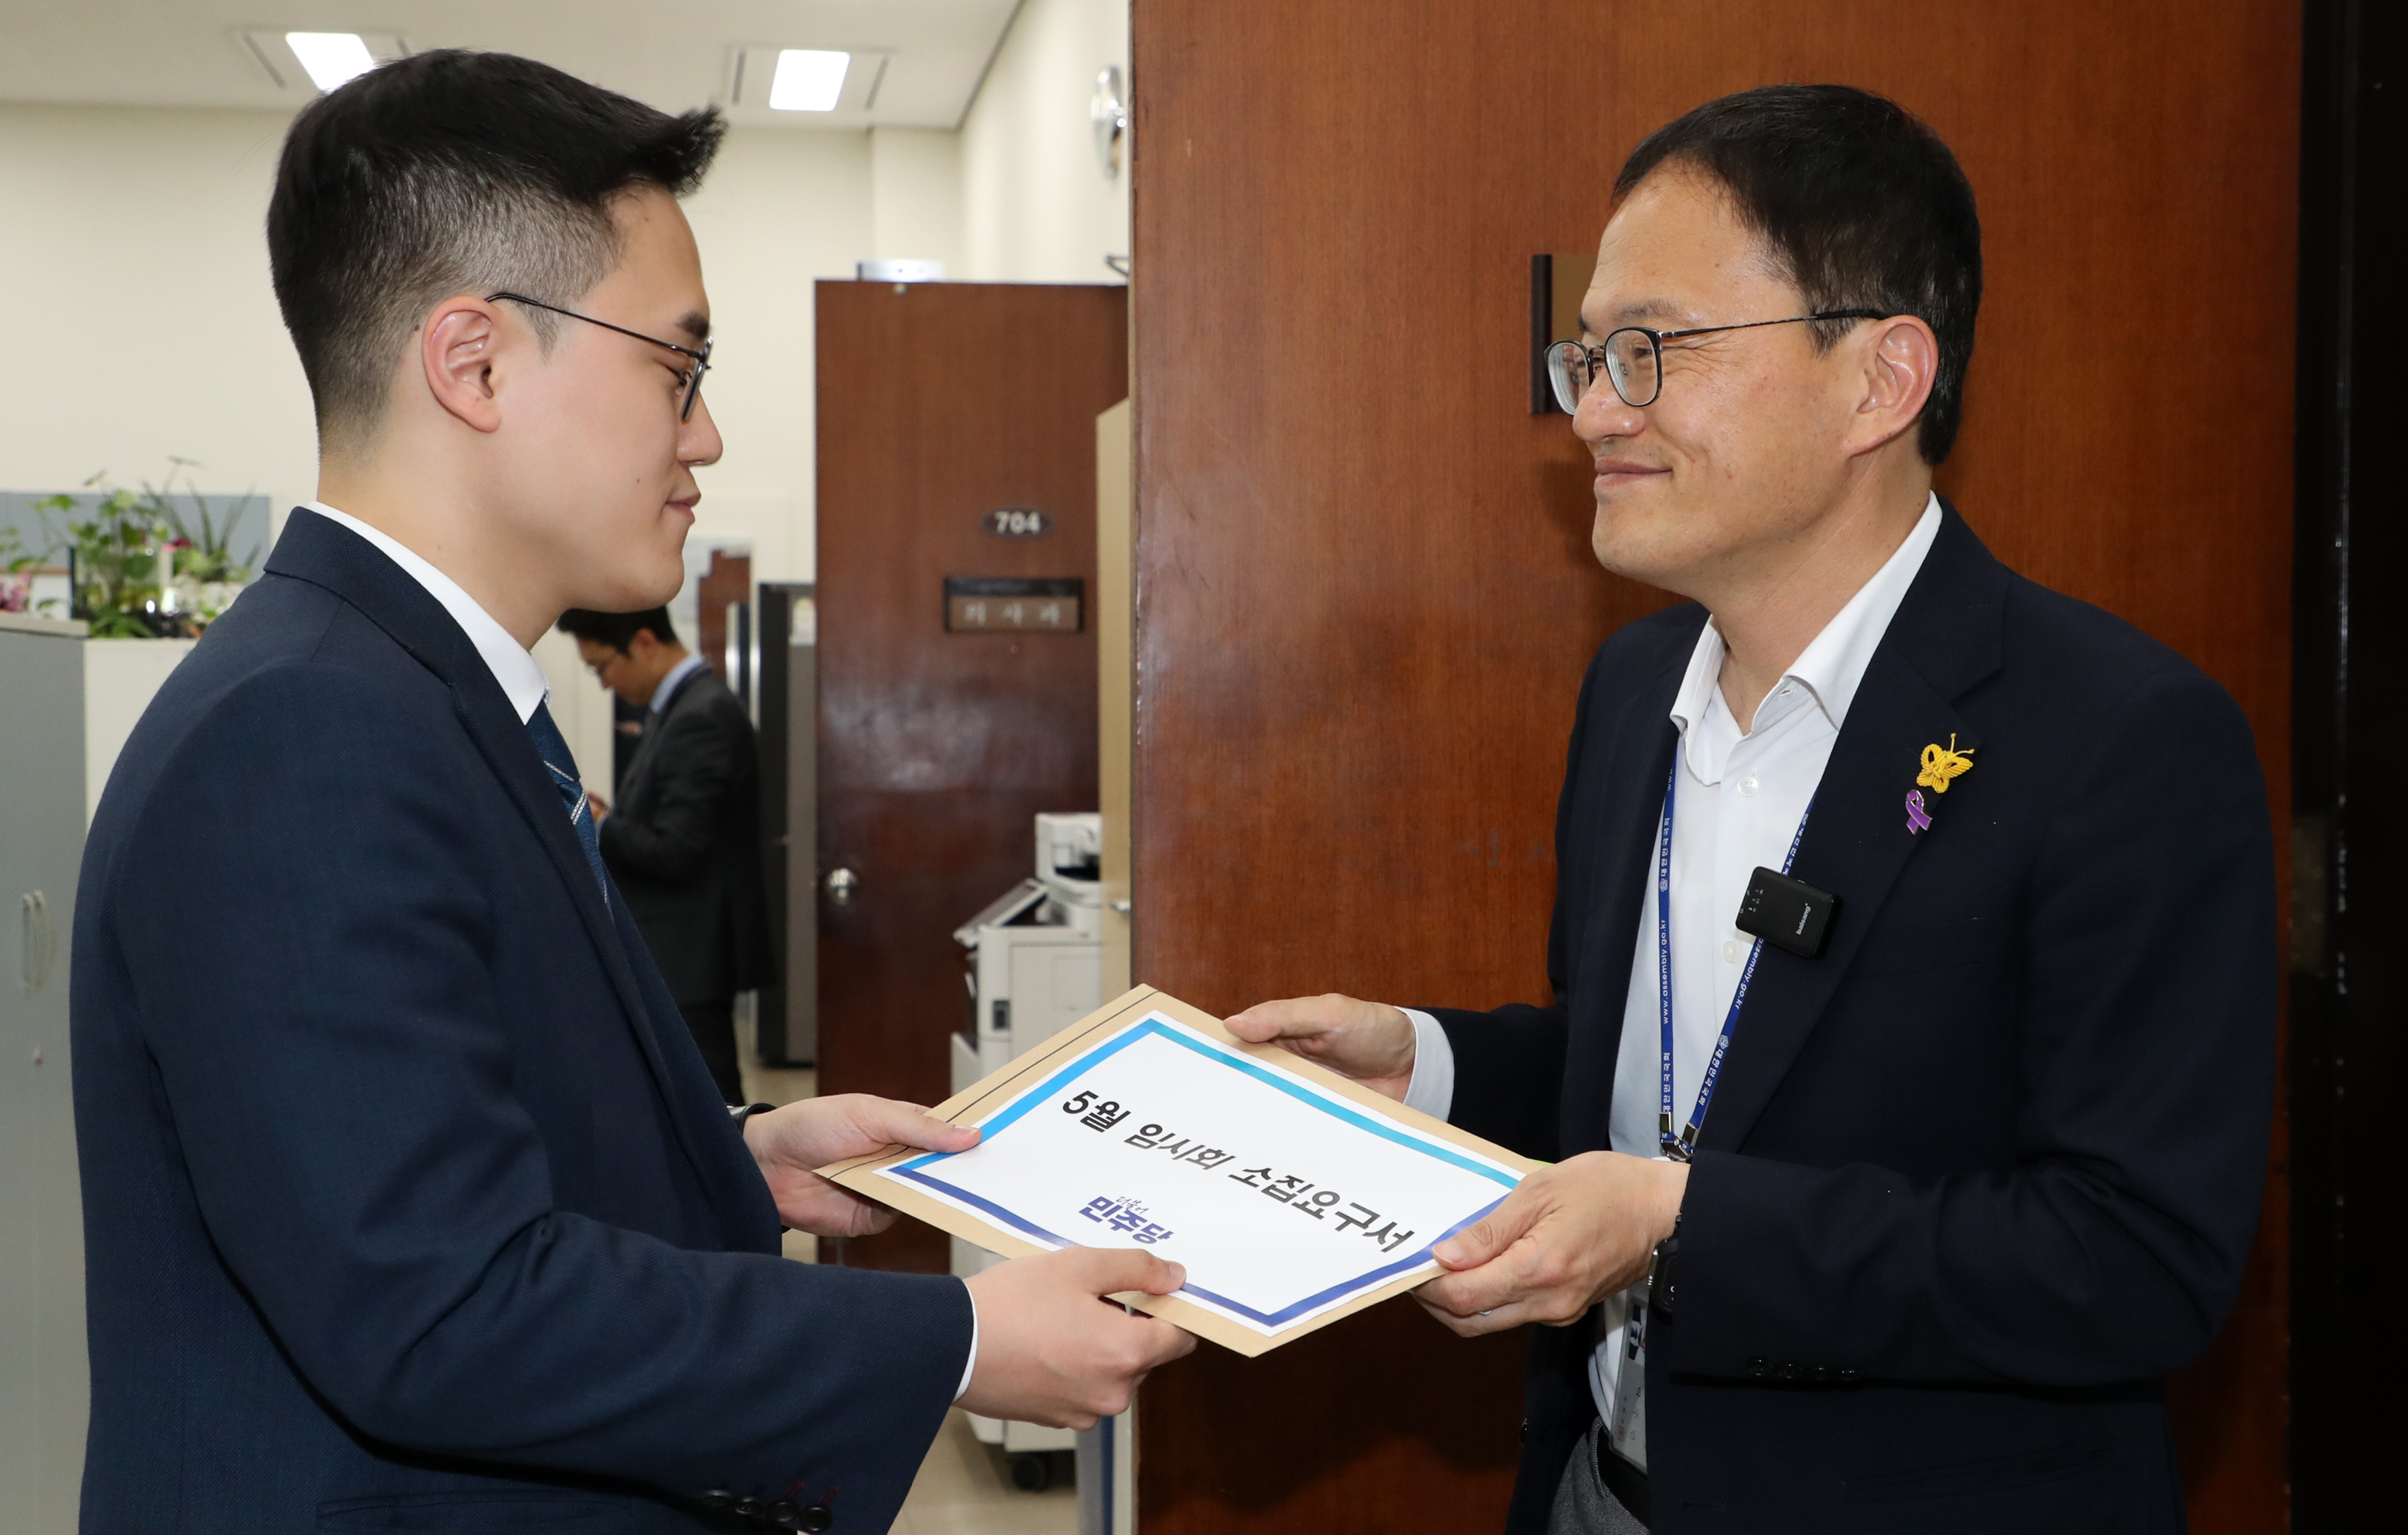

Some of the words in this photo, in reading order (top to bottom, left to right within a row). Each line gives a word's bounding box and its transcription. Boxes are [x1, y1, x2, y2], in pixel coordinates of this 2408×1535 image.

[994, 511, 1041, 534] 704
[1660, 919, 1669, 1024] www.assembly.go.kr
[1062, 1090, 1131, 1133] 5월
[1124, 1124, 1237, 1170] 임시회
[1228, 1167, 1415, 1253] 소집요구서
[1078, 1196, 1174, 1244] 민주당
